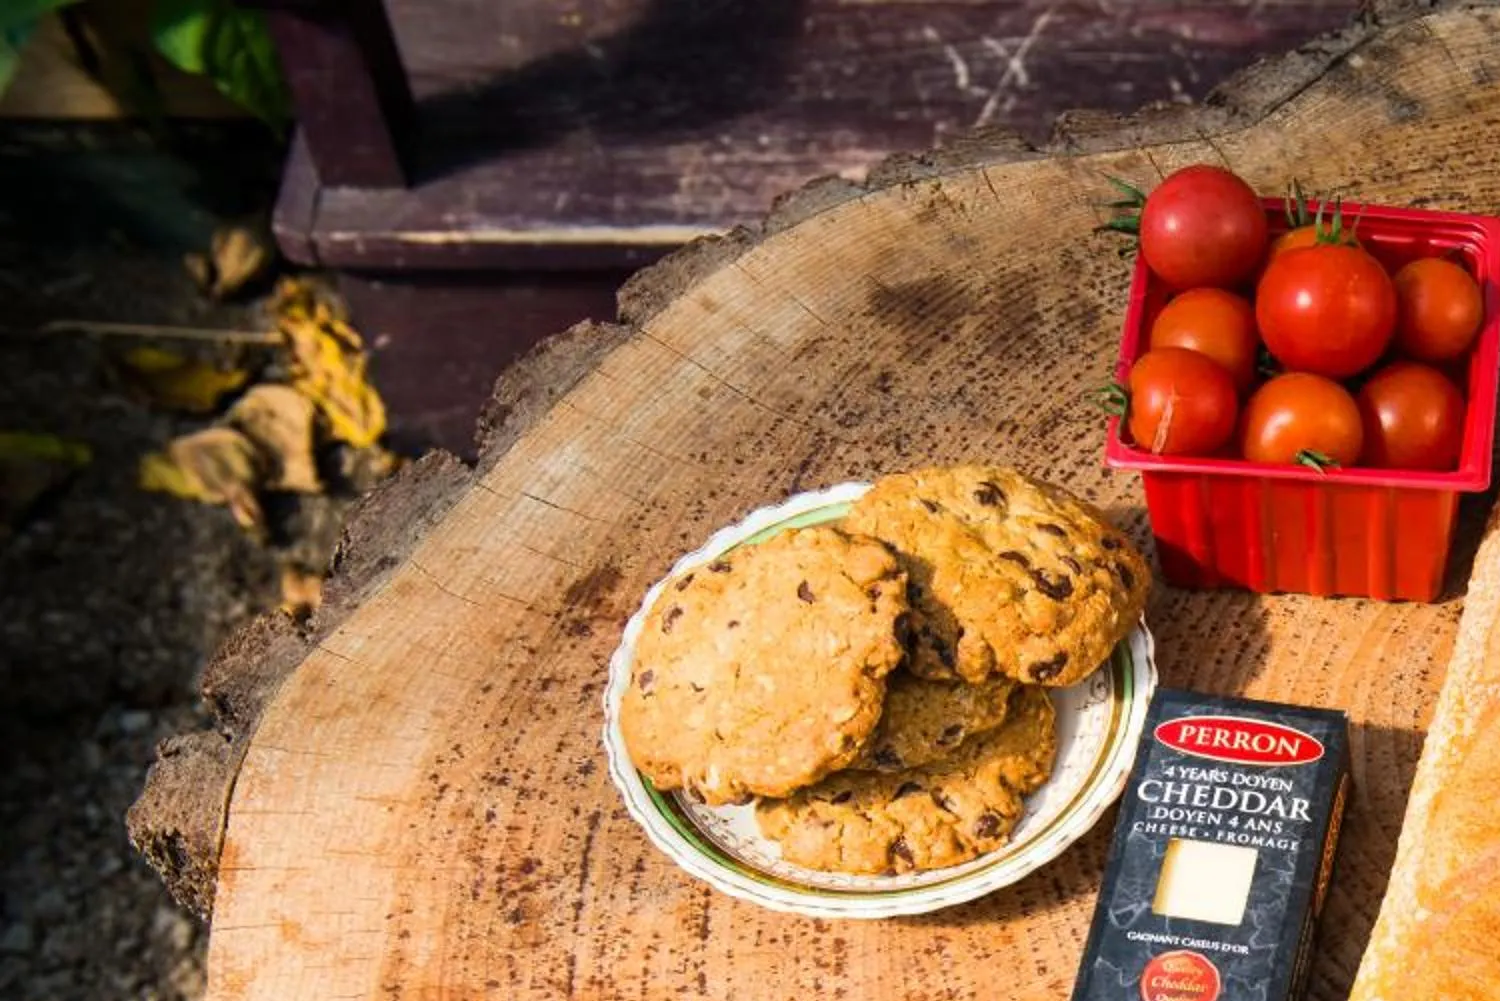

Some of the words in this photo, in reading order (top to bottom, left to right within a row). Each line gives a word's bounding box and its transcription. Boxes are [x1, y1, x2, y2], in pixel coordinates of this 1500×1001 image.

[1177, 725, 1301, 757] PERRON
[1164, 765, 1175, 778] 4
[1176, 766, 1230, 785] YEARS
[1232, 771, 1293, 793] DOYEN
[1137, 779, 1312, 822] CHEDDAR
[1154, 807, 1223, 825] DOYEN
[1228, 814, 1239, 828] 4
[1243, 817, 1283, 834] ANS
[1133, 821, 1197, 838] CHEESE
[1216, 830, 1299, 851] FROMAGE
